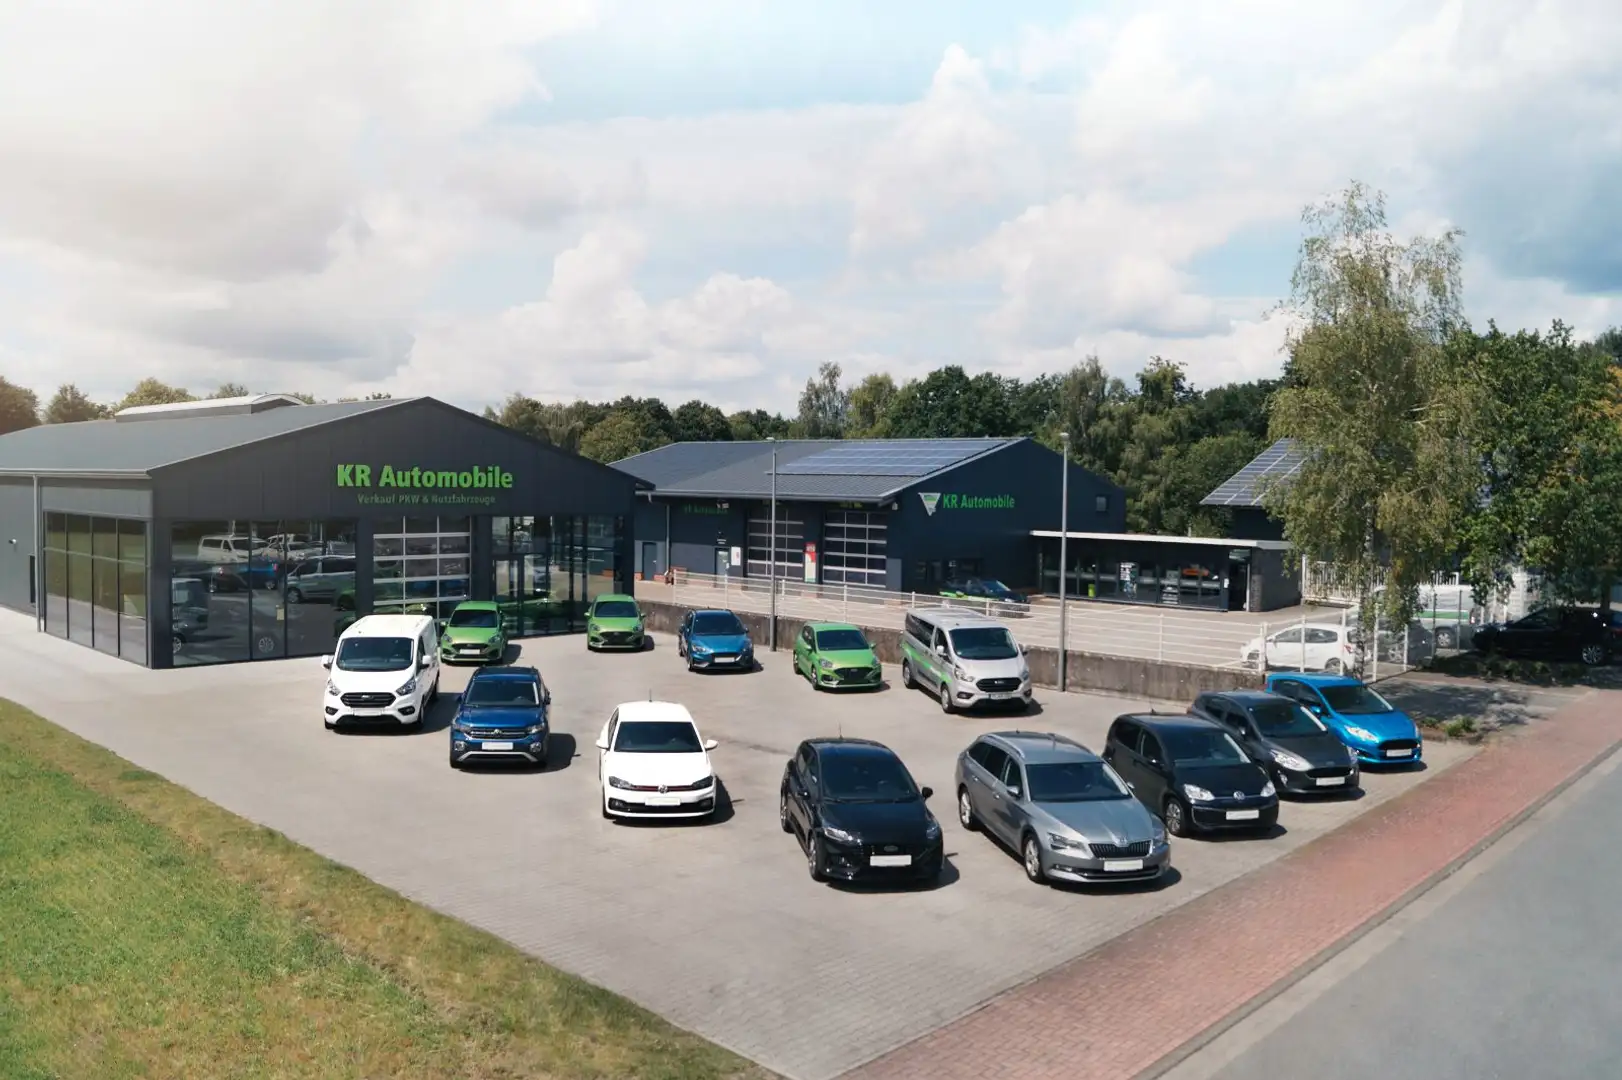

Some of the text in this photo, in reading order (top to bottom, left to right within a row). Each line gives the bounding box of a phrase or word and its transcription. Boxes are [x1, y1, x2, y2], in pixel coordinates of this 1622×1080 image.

[337, 464, 513, 488] KR Automobile
[357, 493, 395, 504] Verkauf
[399, 494, 420, 504] PKW
[431, 494, 496, 506] Nutzfahrzeuge
[943, 494, 1015, 508] KR Automobile
